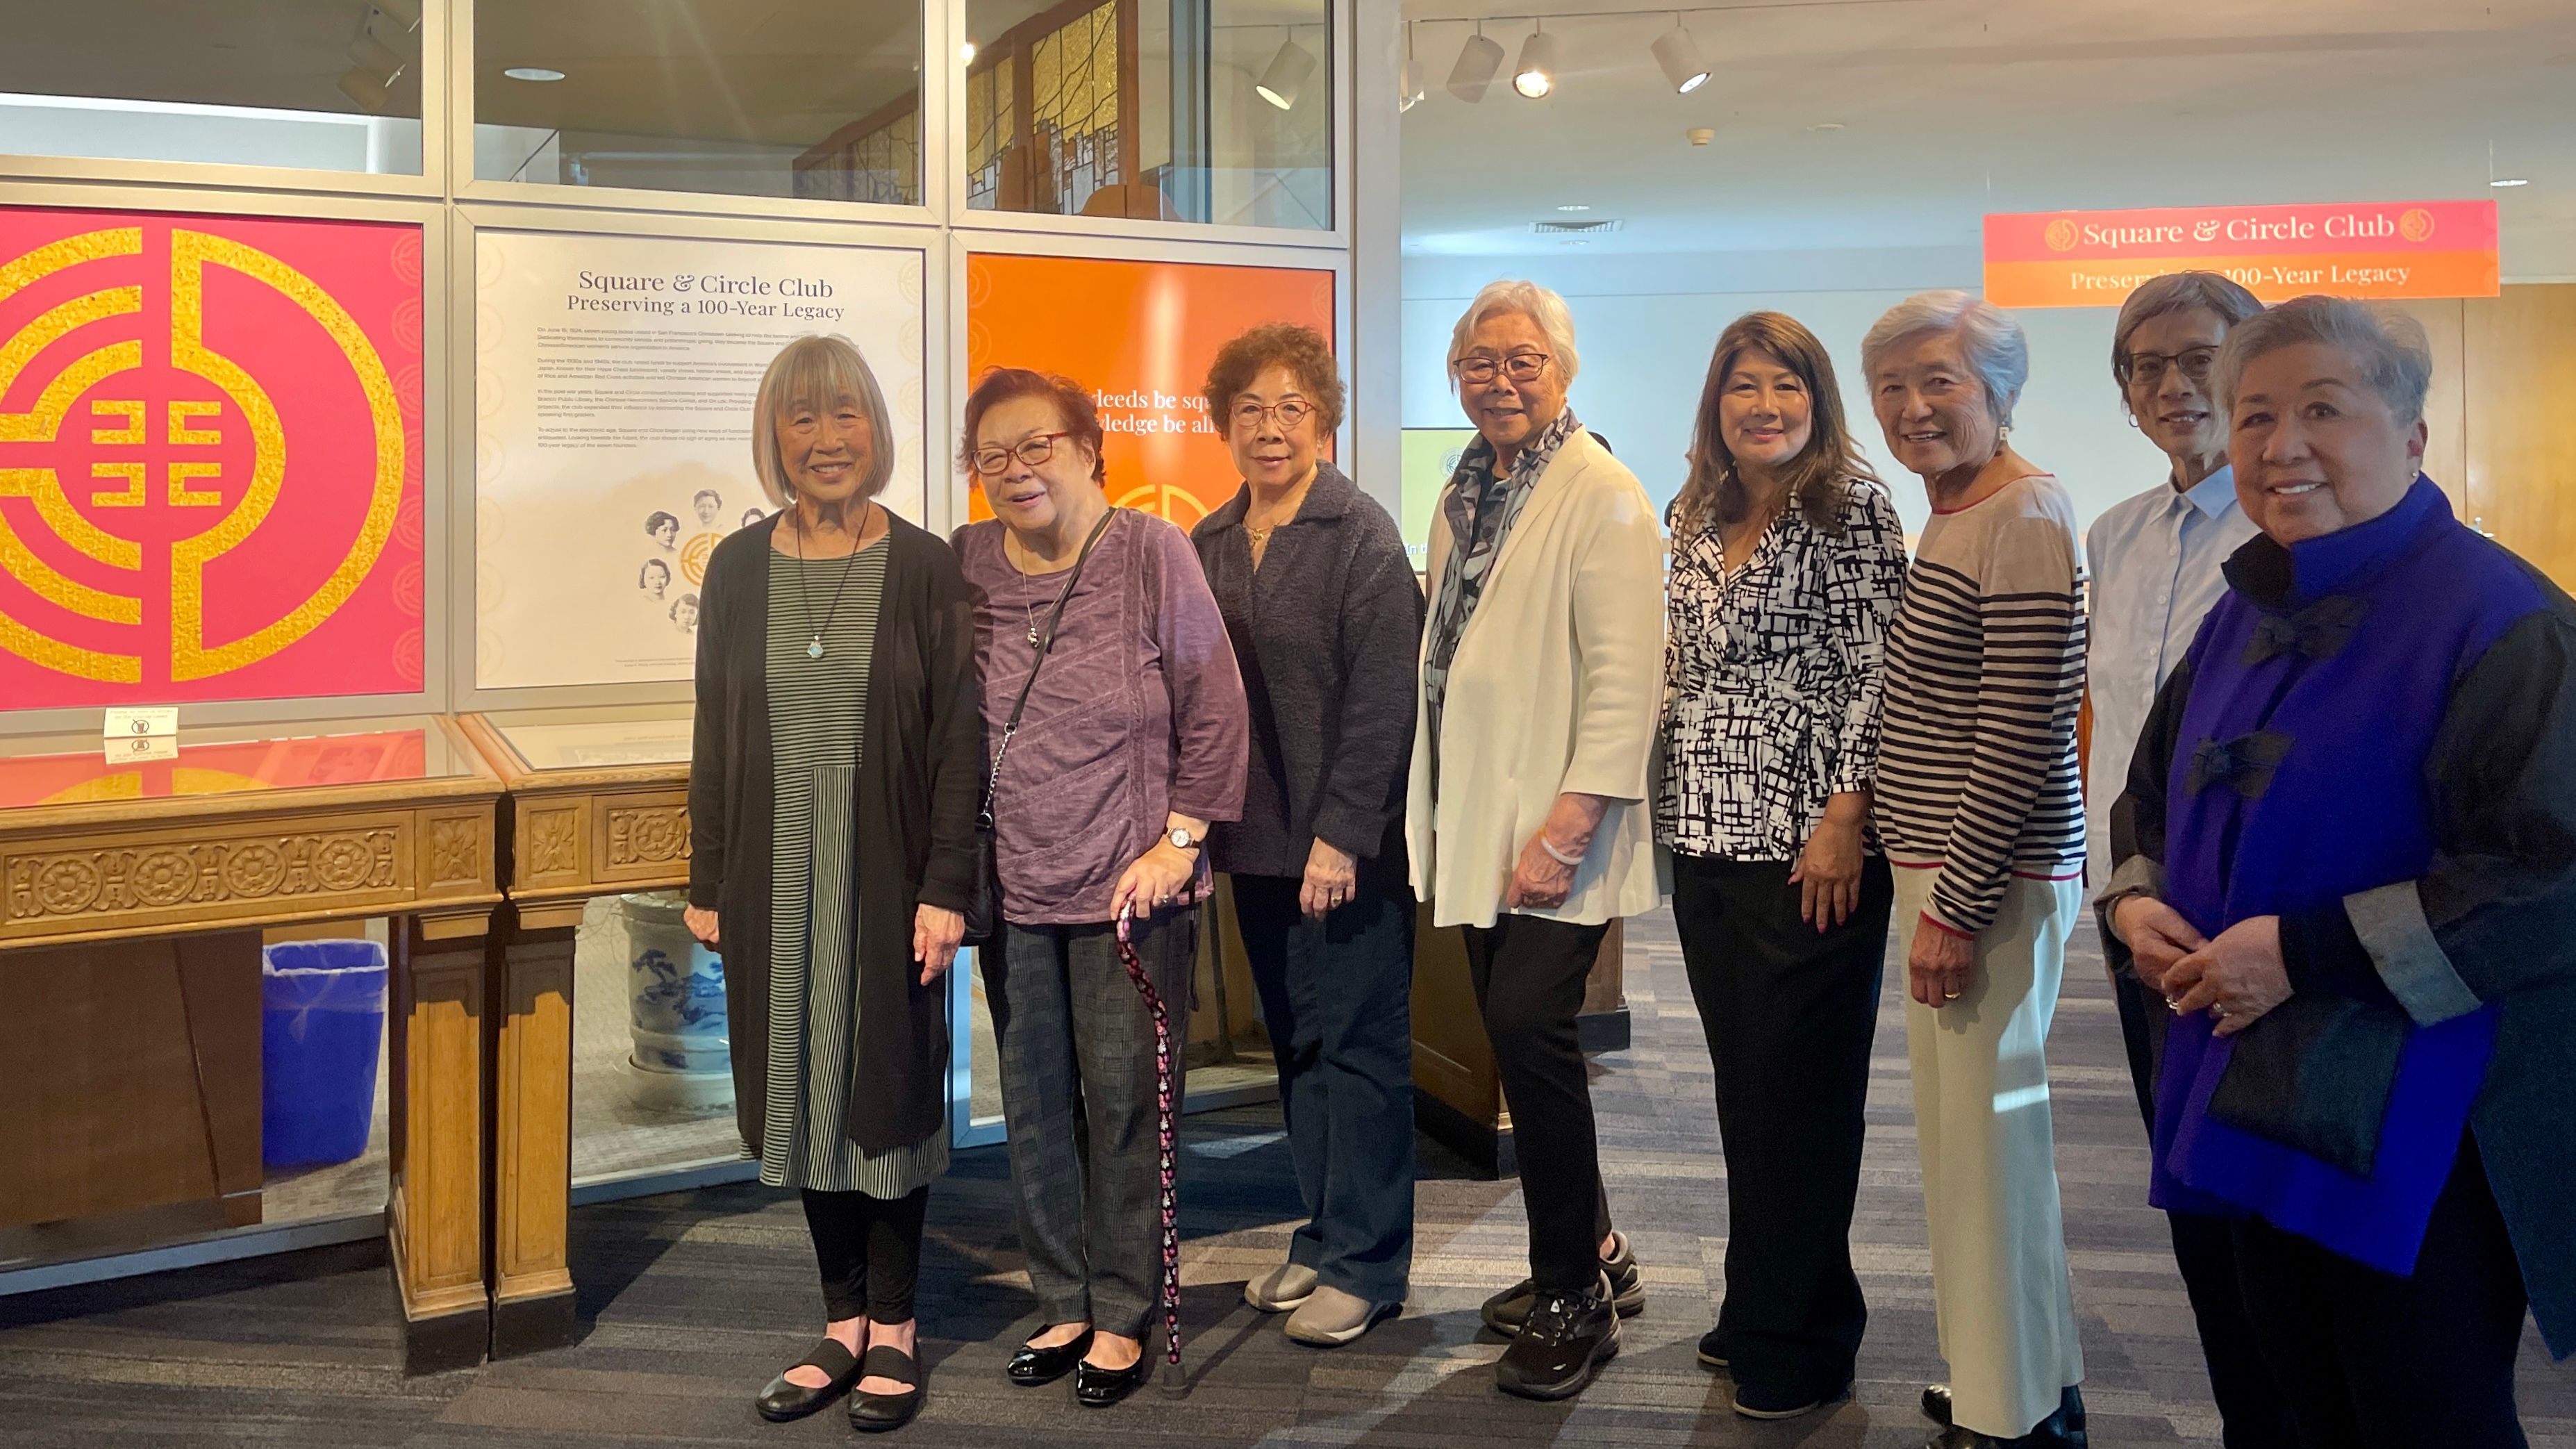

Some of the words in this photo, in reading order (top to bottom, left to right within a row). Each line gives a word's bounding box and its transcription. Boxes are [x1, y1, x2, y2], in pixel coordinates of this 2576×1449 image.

[2084, 222, 2184, 248] Square
[2193, 220, 2220, 242] &
[2227, 216, 2314, 241] Circle
[2324, 214, 2395, 238] Club
[579, 270, 665, 293] Square
[673, 274, 695, 292] &
[700, 275, 771, 295] Circle
[779, 278, 833, 297] Club
[2331, 265, 2410, 285] Legacy
[567, 295, 674, 316] Preserving
[681, 301, 691, 313] a
[698, 299, 776, 316] 100-Year
[783, 303, 844, 322] Legacy
[1154, 390, 1177, 408] be
[1163, 415, 1186, 433] be
